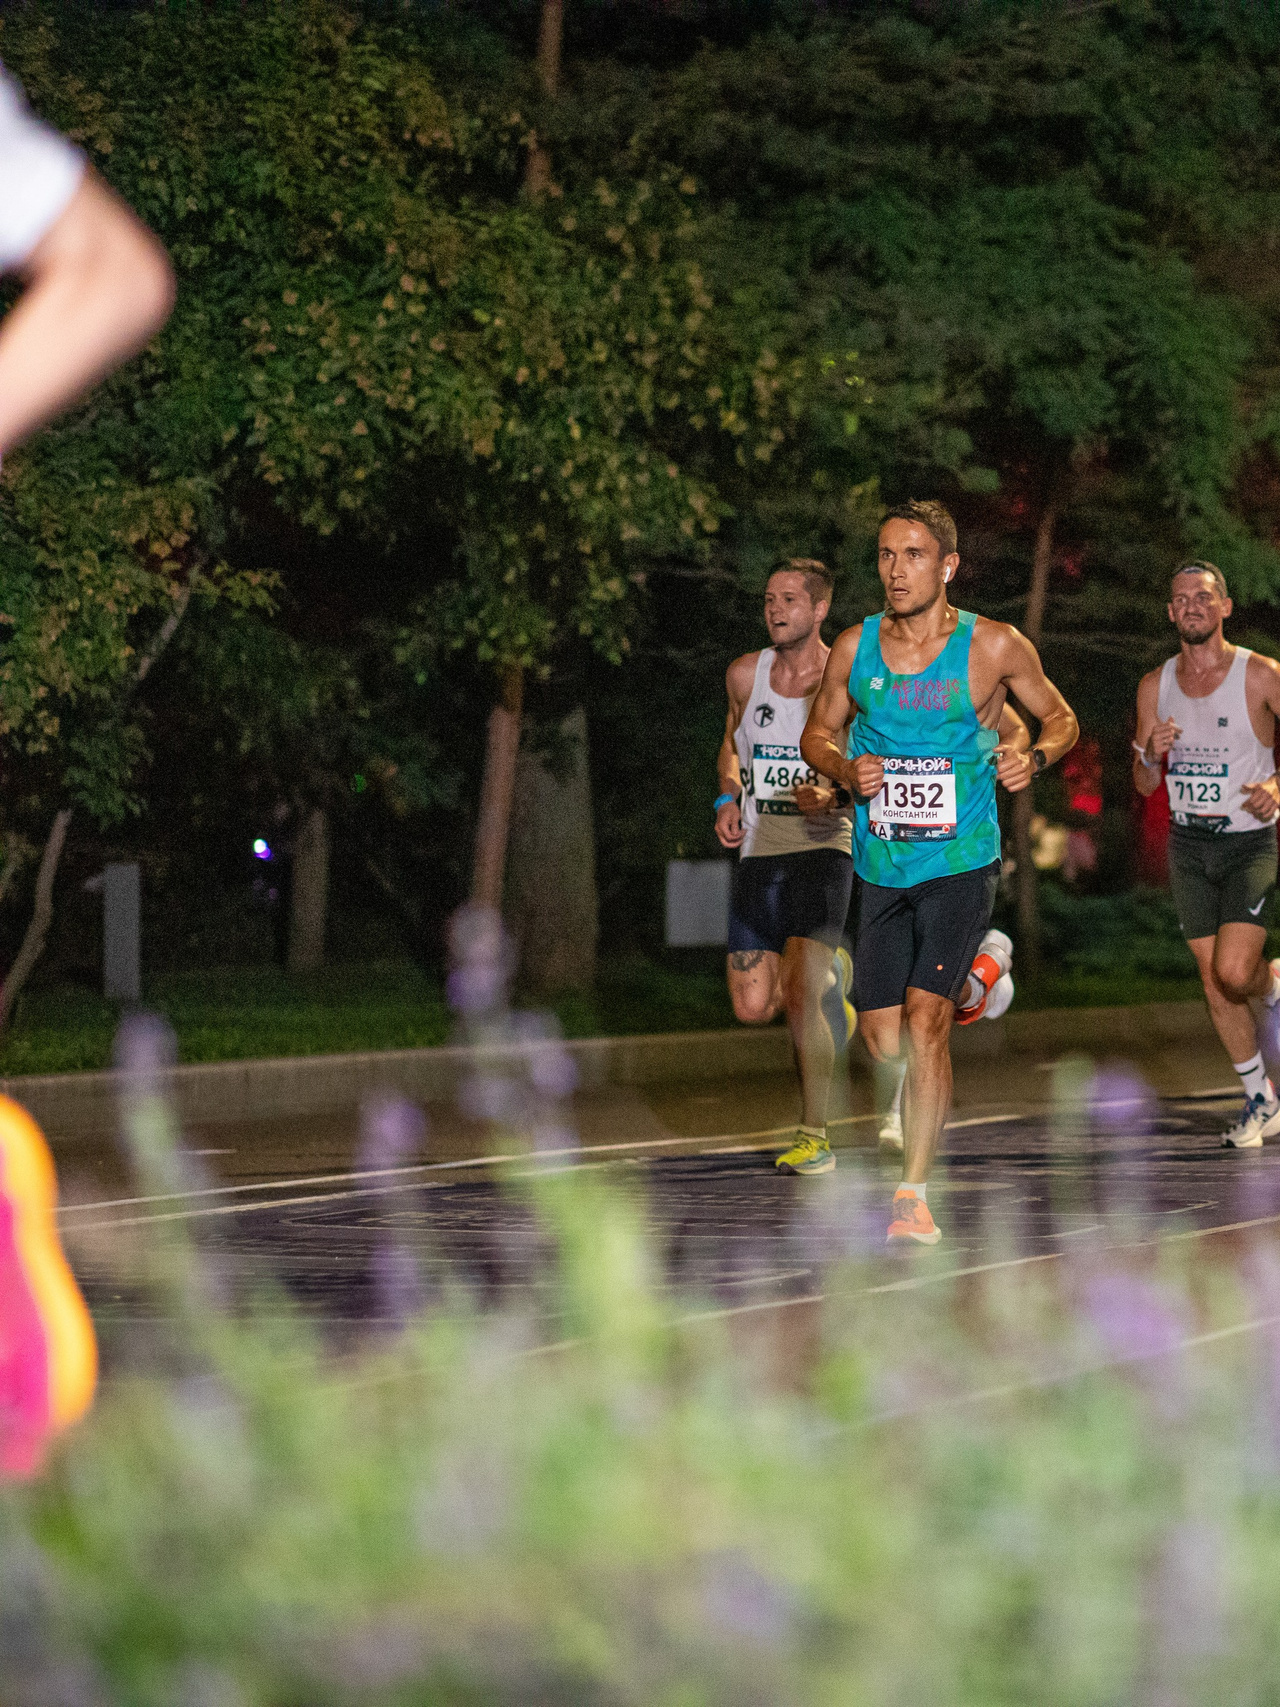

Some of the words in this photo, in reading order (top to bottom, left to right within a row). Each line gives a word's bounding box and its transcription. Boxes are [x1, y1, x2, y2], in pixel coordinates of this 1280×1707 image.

[891, 679, 960, 695] AEROBIC
[898, 694, 952, 712] HOUSE
[763, 766, 819, 788] 4868
[881, 781, 944, 809] 1352
[1175, 781, 1221, 802] 7123
[882, 809, 938, 819] КОНСТАНТИН
